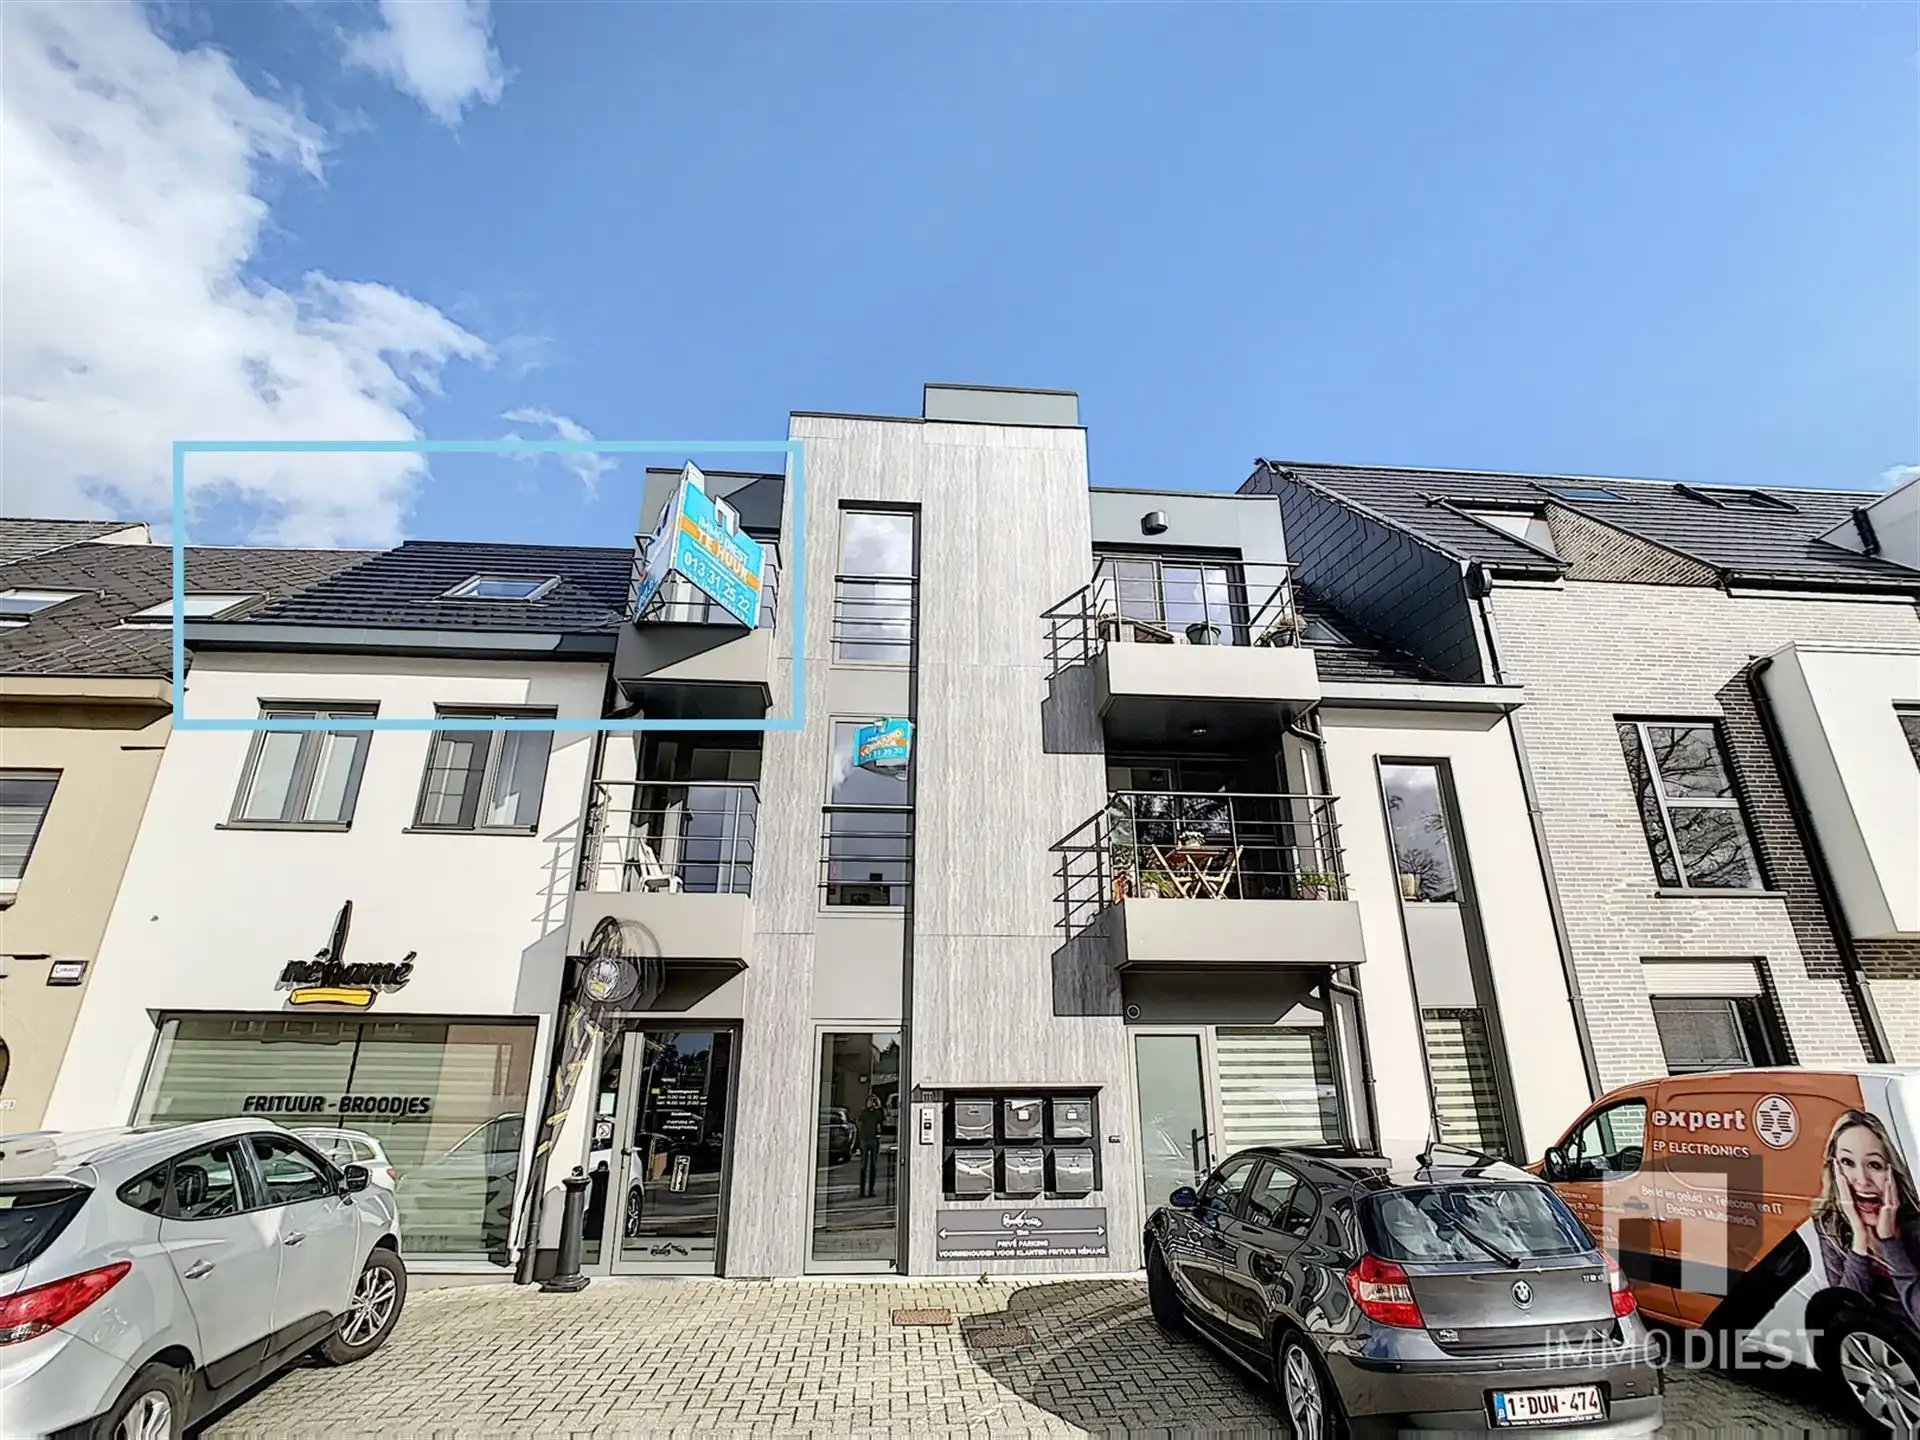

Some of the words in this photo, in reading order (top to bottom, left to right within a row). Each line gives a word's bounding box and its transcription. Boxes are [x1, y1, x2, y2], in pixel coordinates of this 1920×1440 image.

[684, 552, 706, 577] 013
[707, 570, 721, 589] 31
[722, 583, 736, 601] 25
[737, 595, 750, 614] 22
[242, 1095, 325, 1113] FRITUUR
[338, 1096, 431, 1117] BROODJES
[1651, 1110, 1746, 1132] expert
[1653, 1140, 1666, 1151] EP
[1668, 1142, 1750, 1158] ELECTRONICS
[1771, 1203, 1784, 1215] IT
